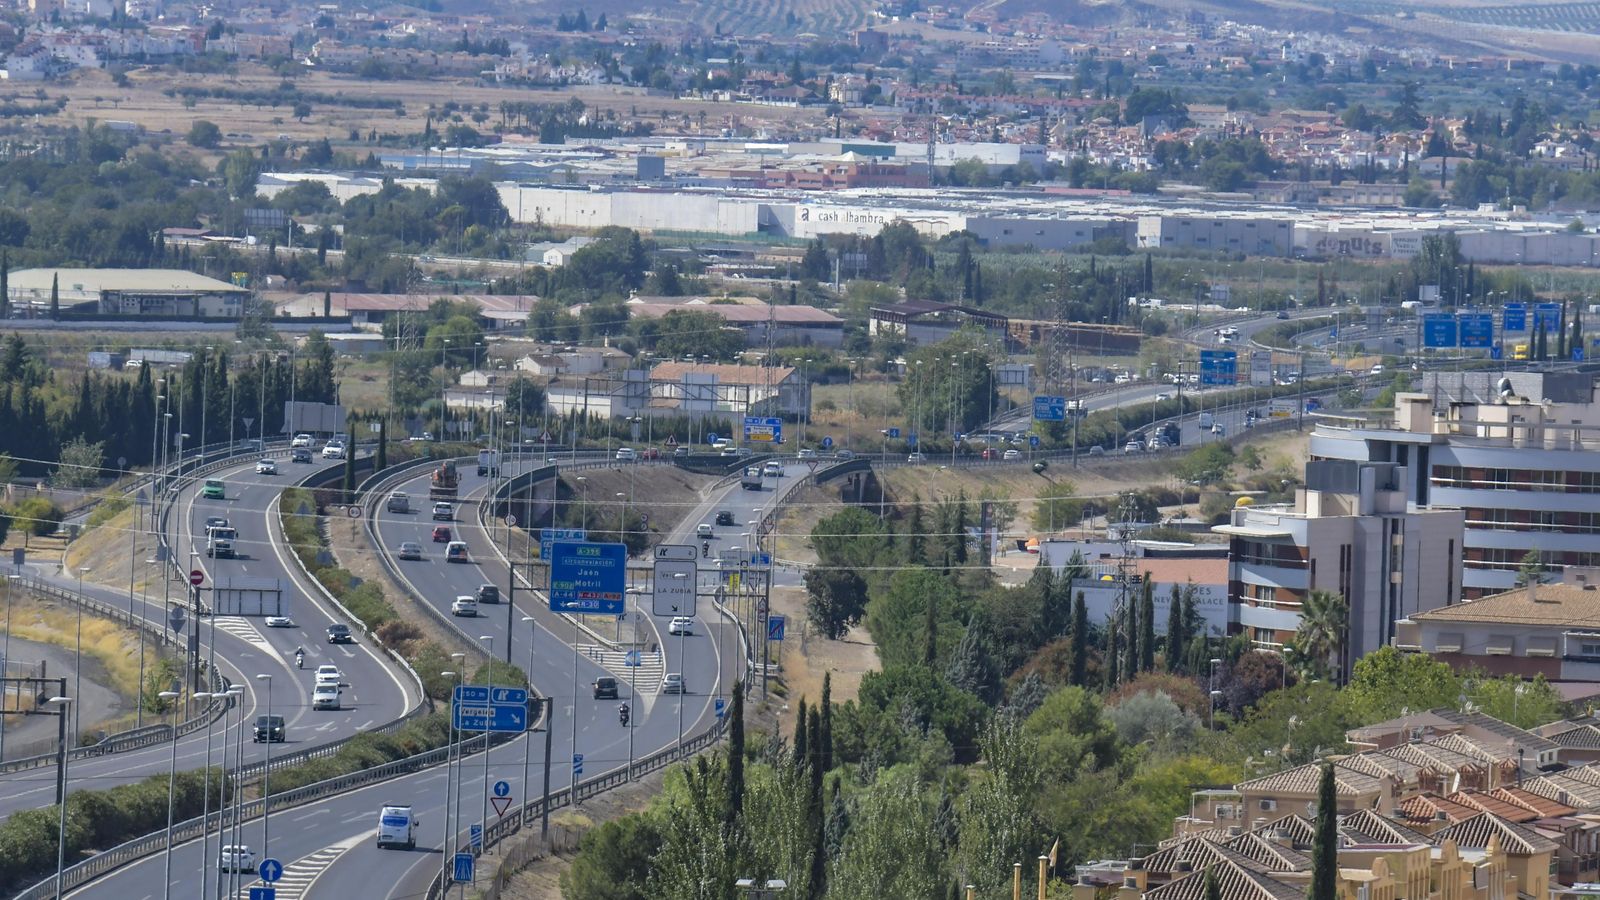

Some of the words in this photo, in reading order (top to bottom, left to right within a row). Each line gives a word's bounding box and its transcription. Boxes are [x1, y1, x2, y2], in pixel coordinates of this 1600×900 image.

[818, 211, 838, 222] cash
[1316, 235, 1382, 255] donuts
[578, 568, 599, 576] Jaén
[575, 580, 601, 588] Motril
